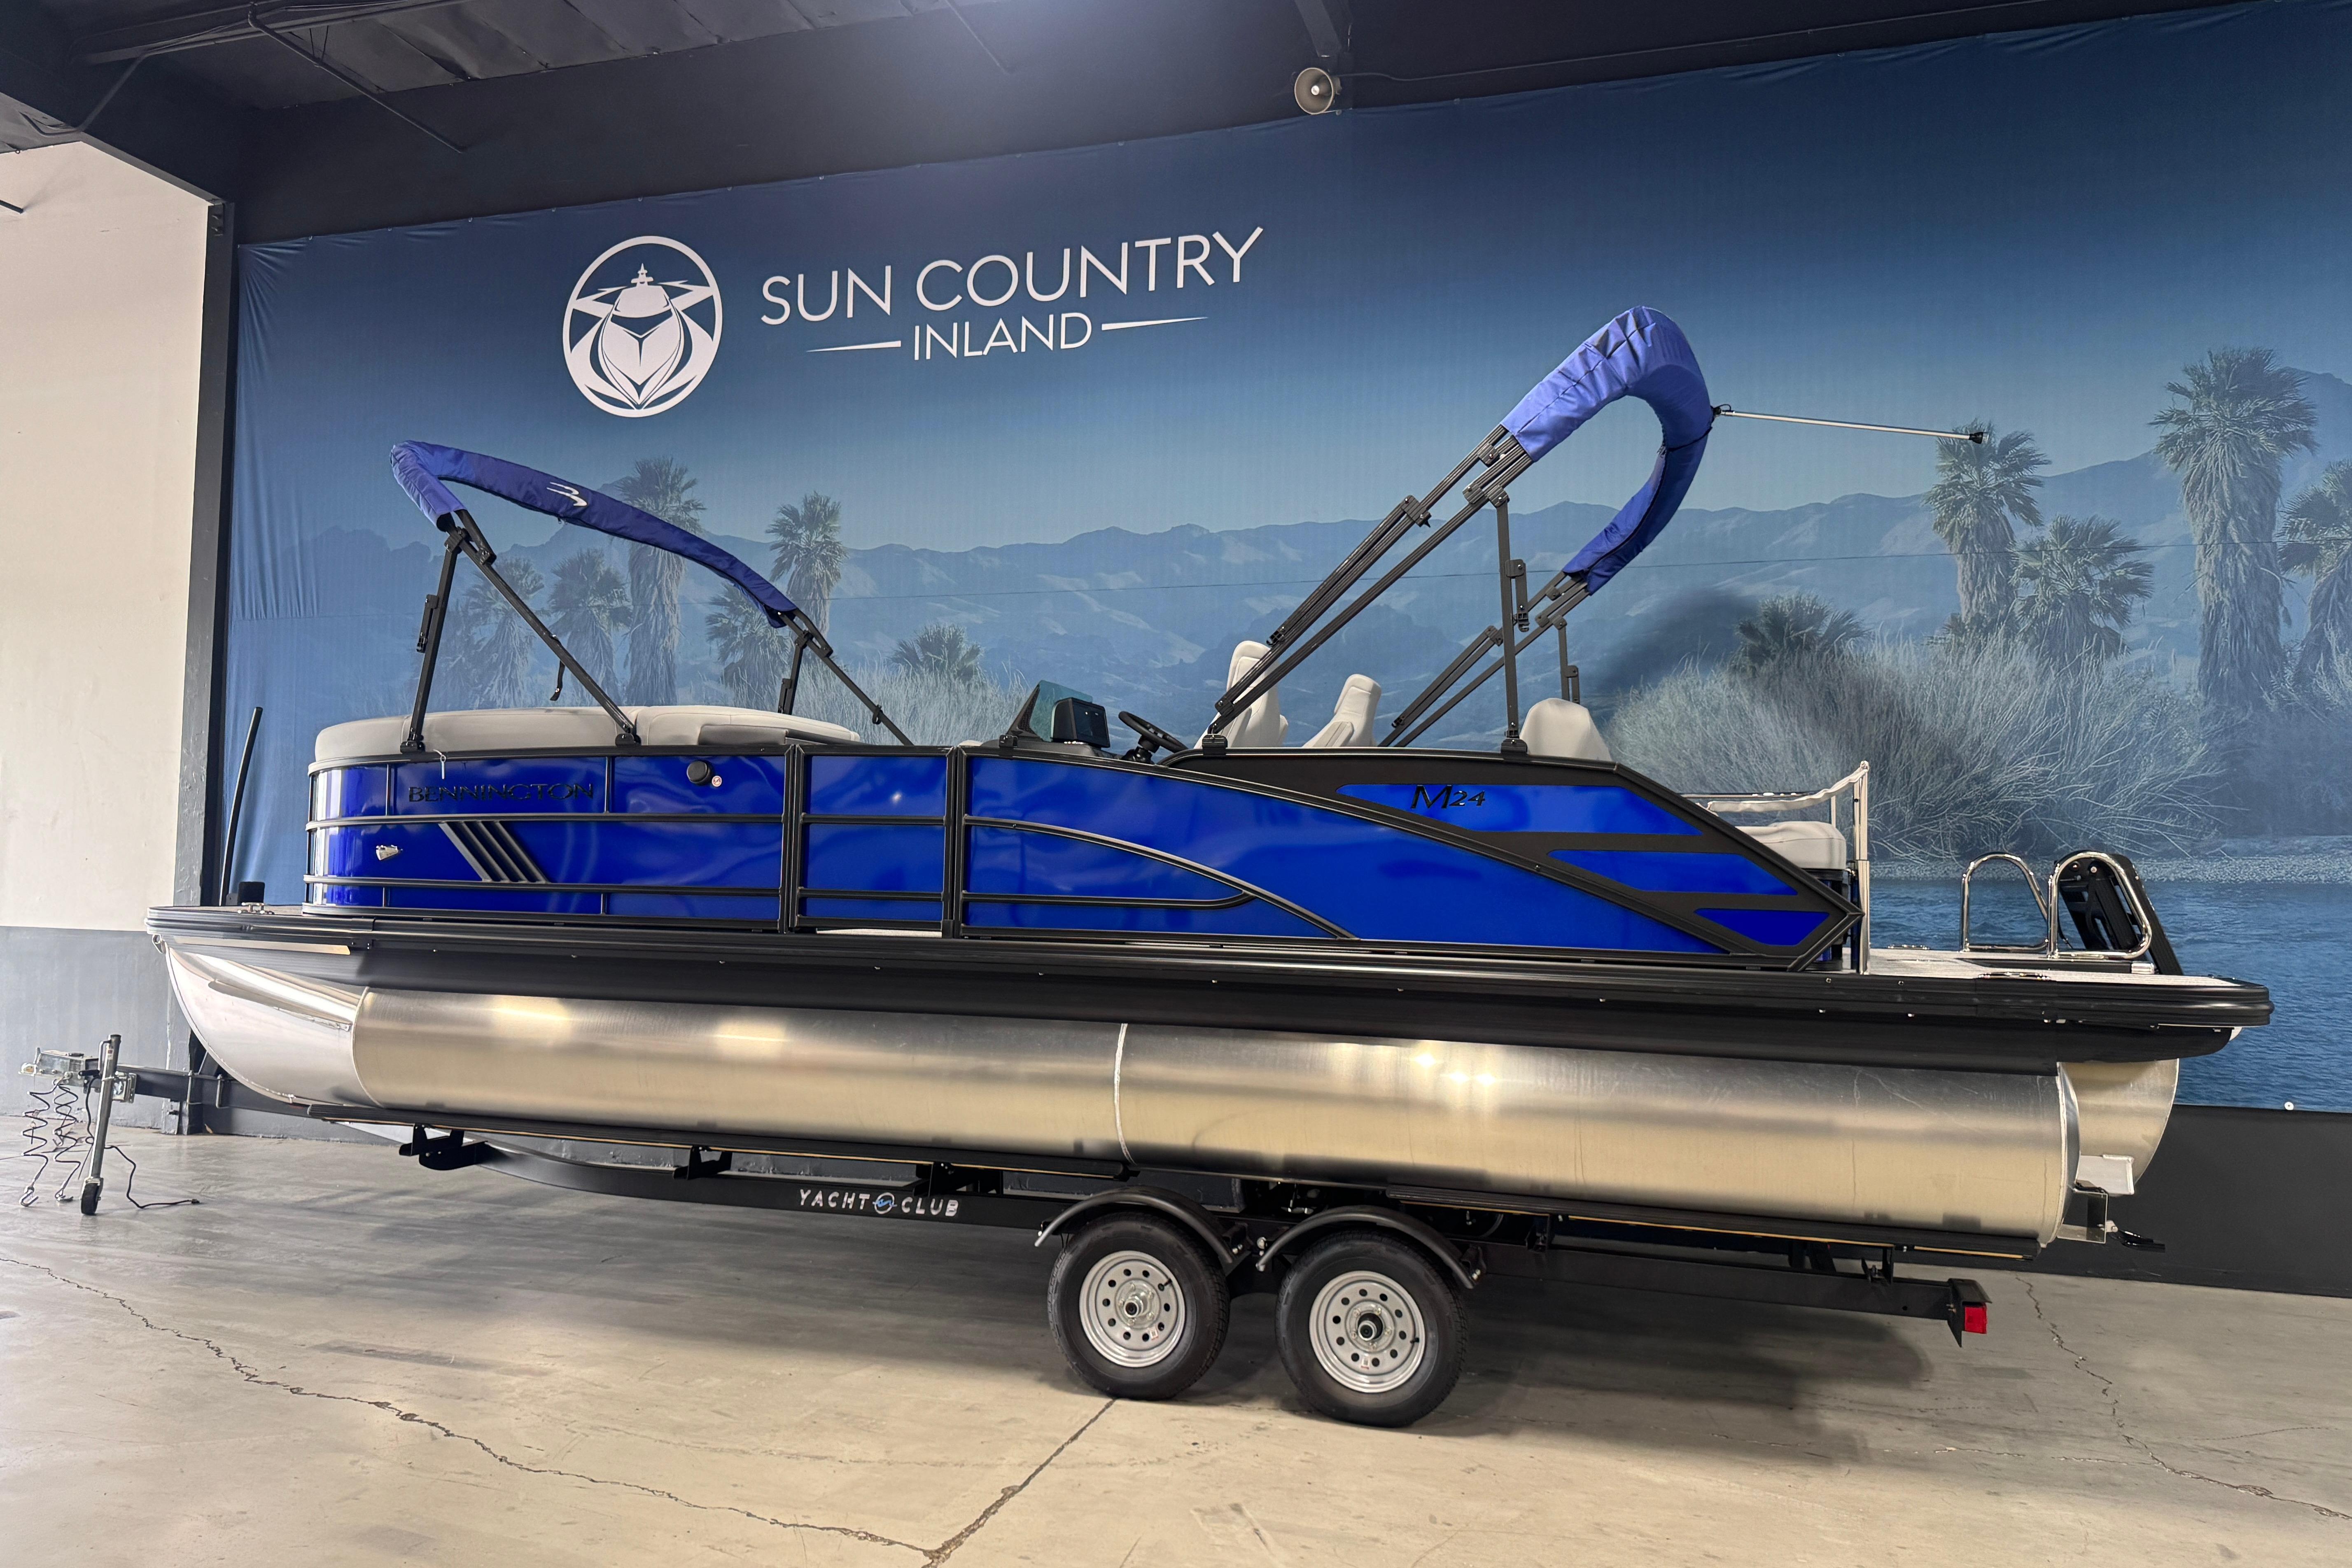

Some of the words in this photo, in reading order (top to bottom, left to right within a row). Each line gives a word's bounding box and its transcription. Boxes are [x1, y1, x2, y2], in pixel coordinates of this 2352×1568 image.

[761, 265, 891, 325] SUN
[916, 226, 1264, 311] COUNTRY
[914, 312, 1092, 361] INLAND
[408, 783, 595, 803] BENNINGTON
[800, 1188, 870, 1210] YACHT
[901, 1196, 959, 1217] CLUB
